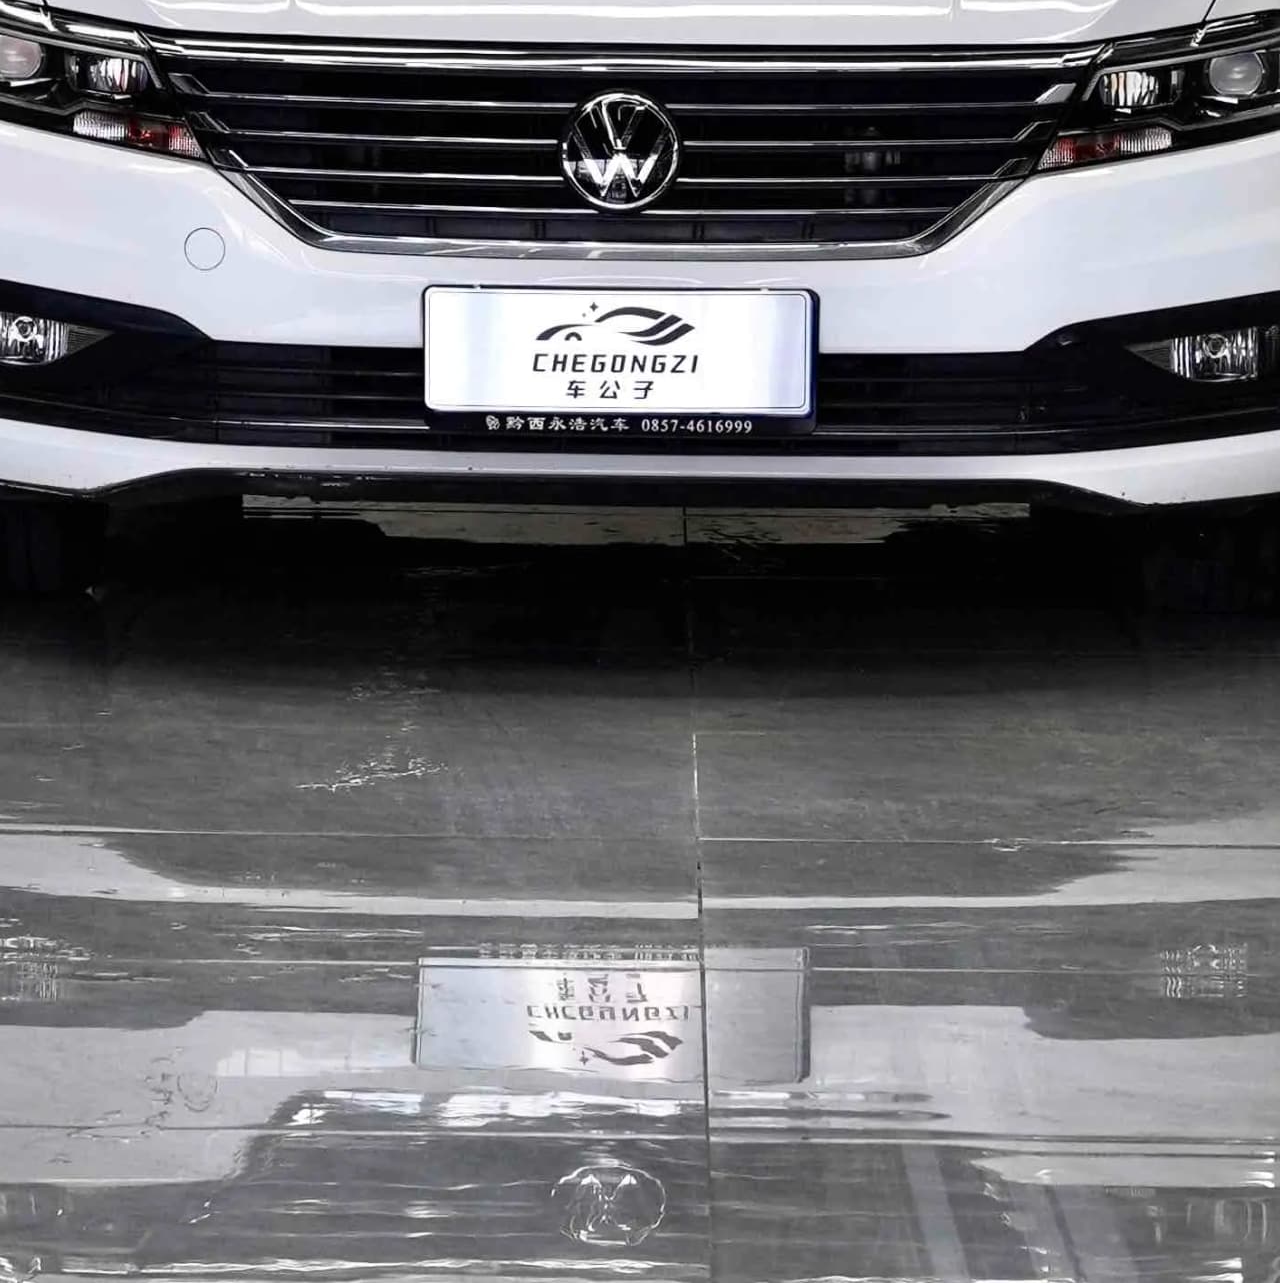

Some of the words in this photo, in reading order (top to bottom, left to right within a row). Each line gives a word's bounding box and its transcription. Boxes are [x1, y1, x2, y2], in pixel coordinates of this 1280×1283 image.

[532, 353, 699, 374] CHEGONGZI
[565, 380, 654, 400] 车公子
[641, 418, 753, 434] 0857-4616999
